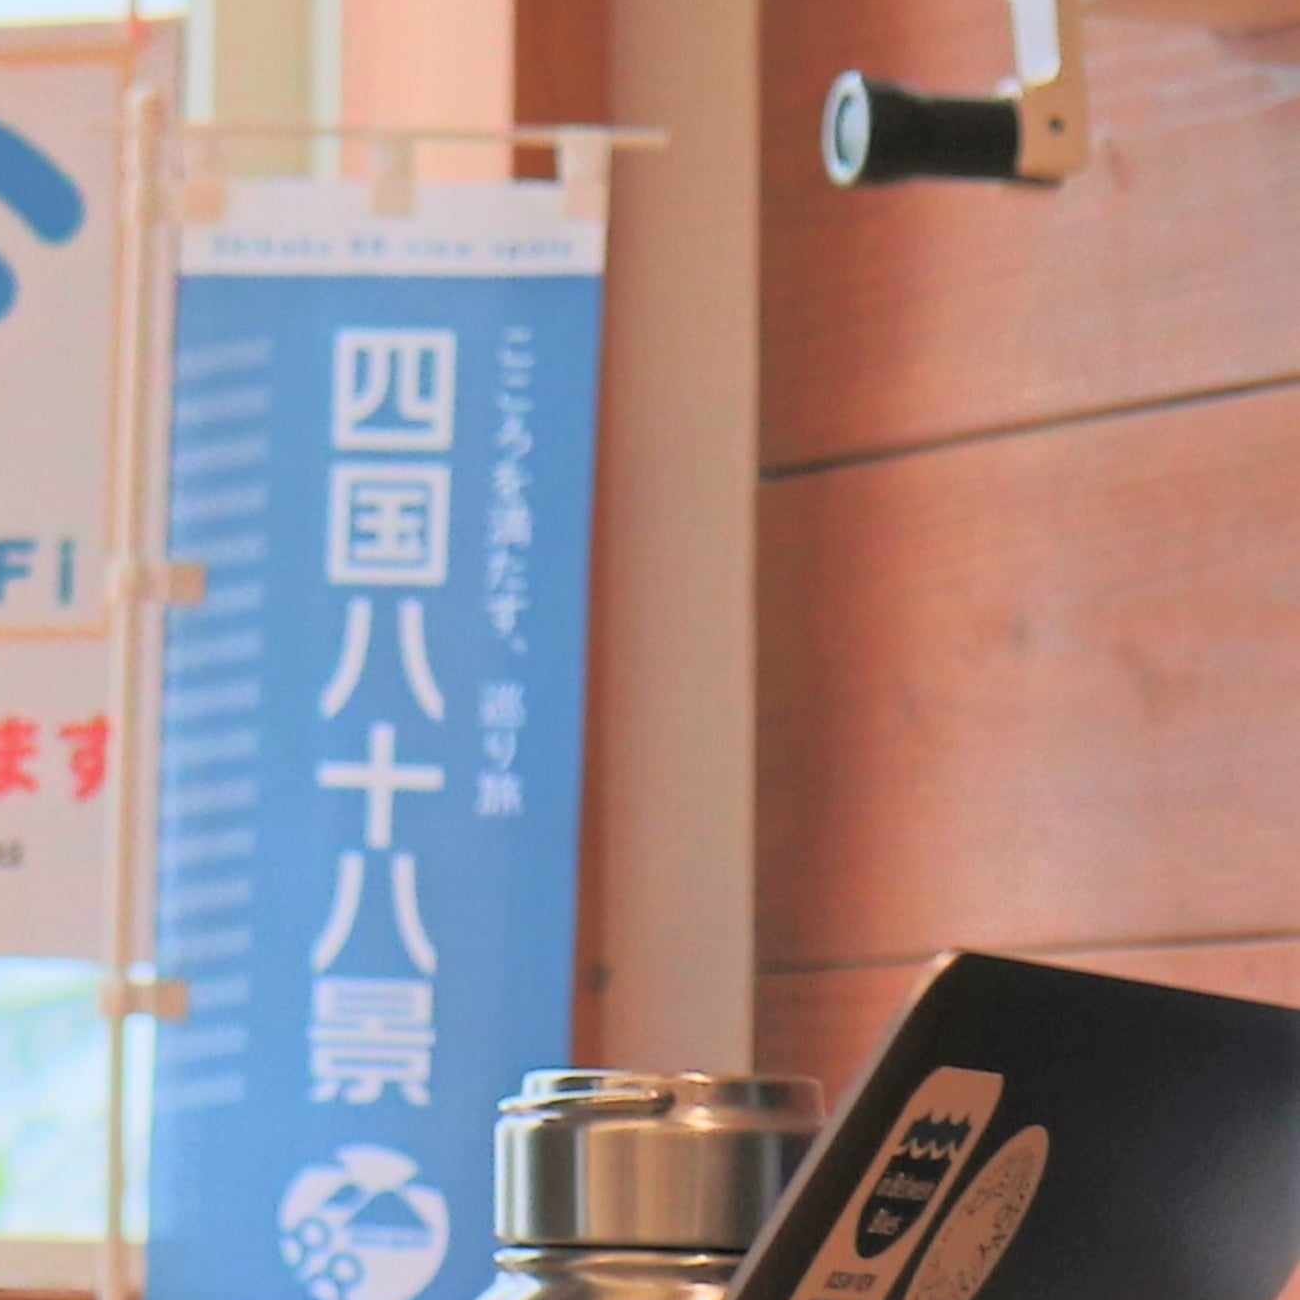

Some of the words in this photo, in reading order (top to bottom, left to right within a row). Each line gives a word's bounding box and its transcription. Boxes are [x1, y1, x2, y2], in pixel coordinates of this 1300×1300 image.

[308, 328, 457, 1105] 四国八十八景
